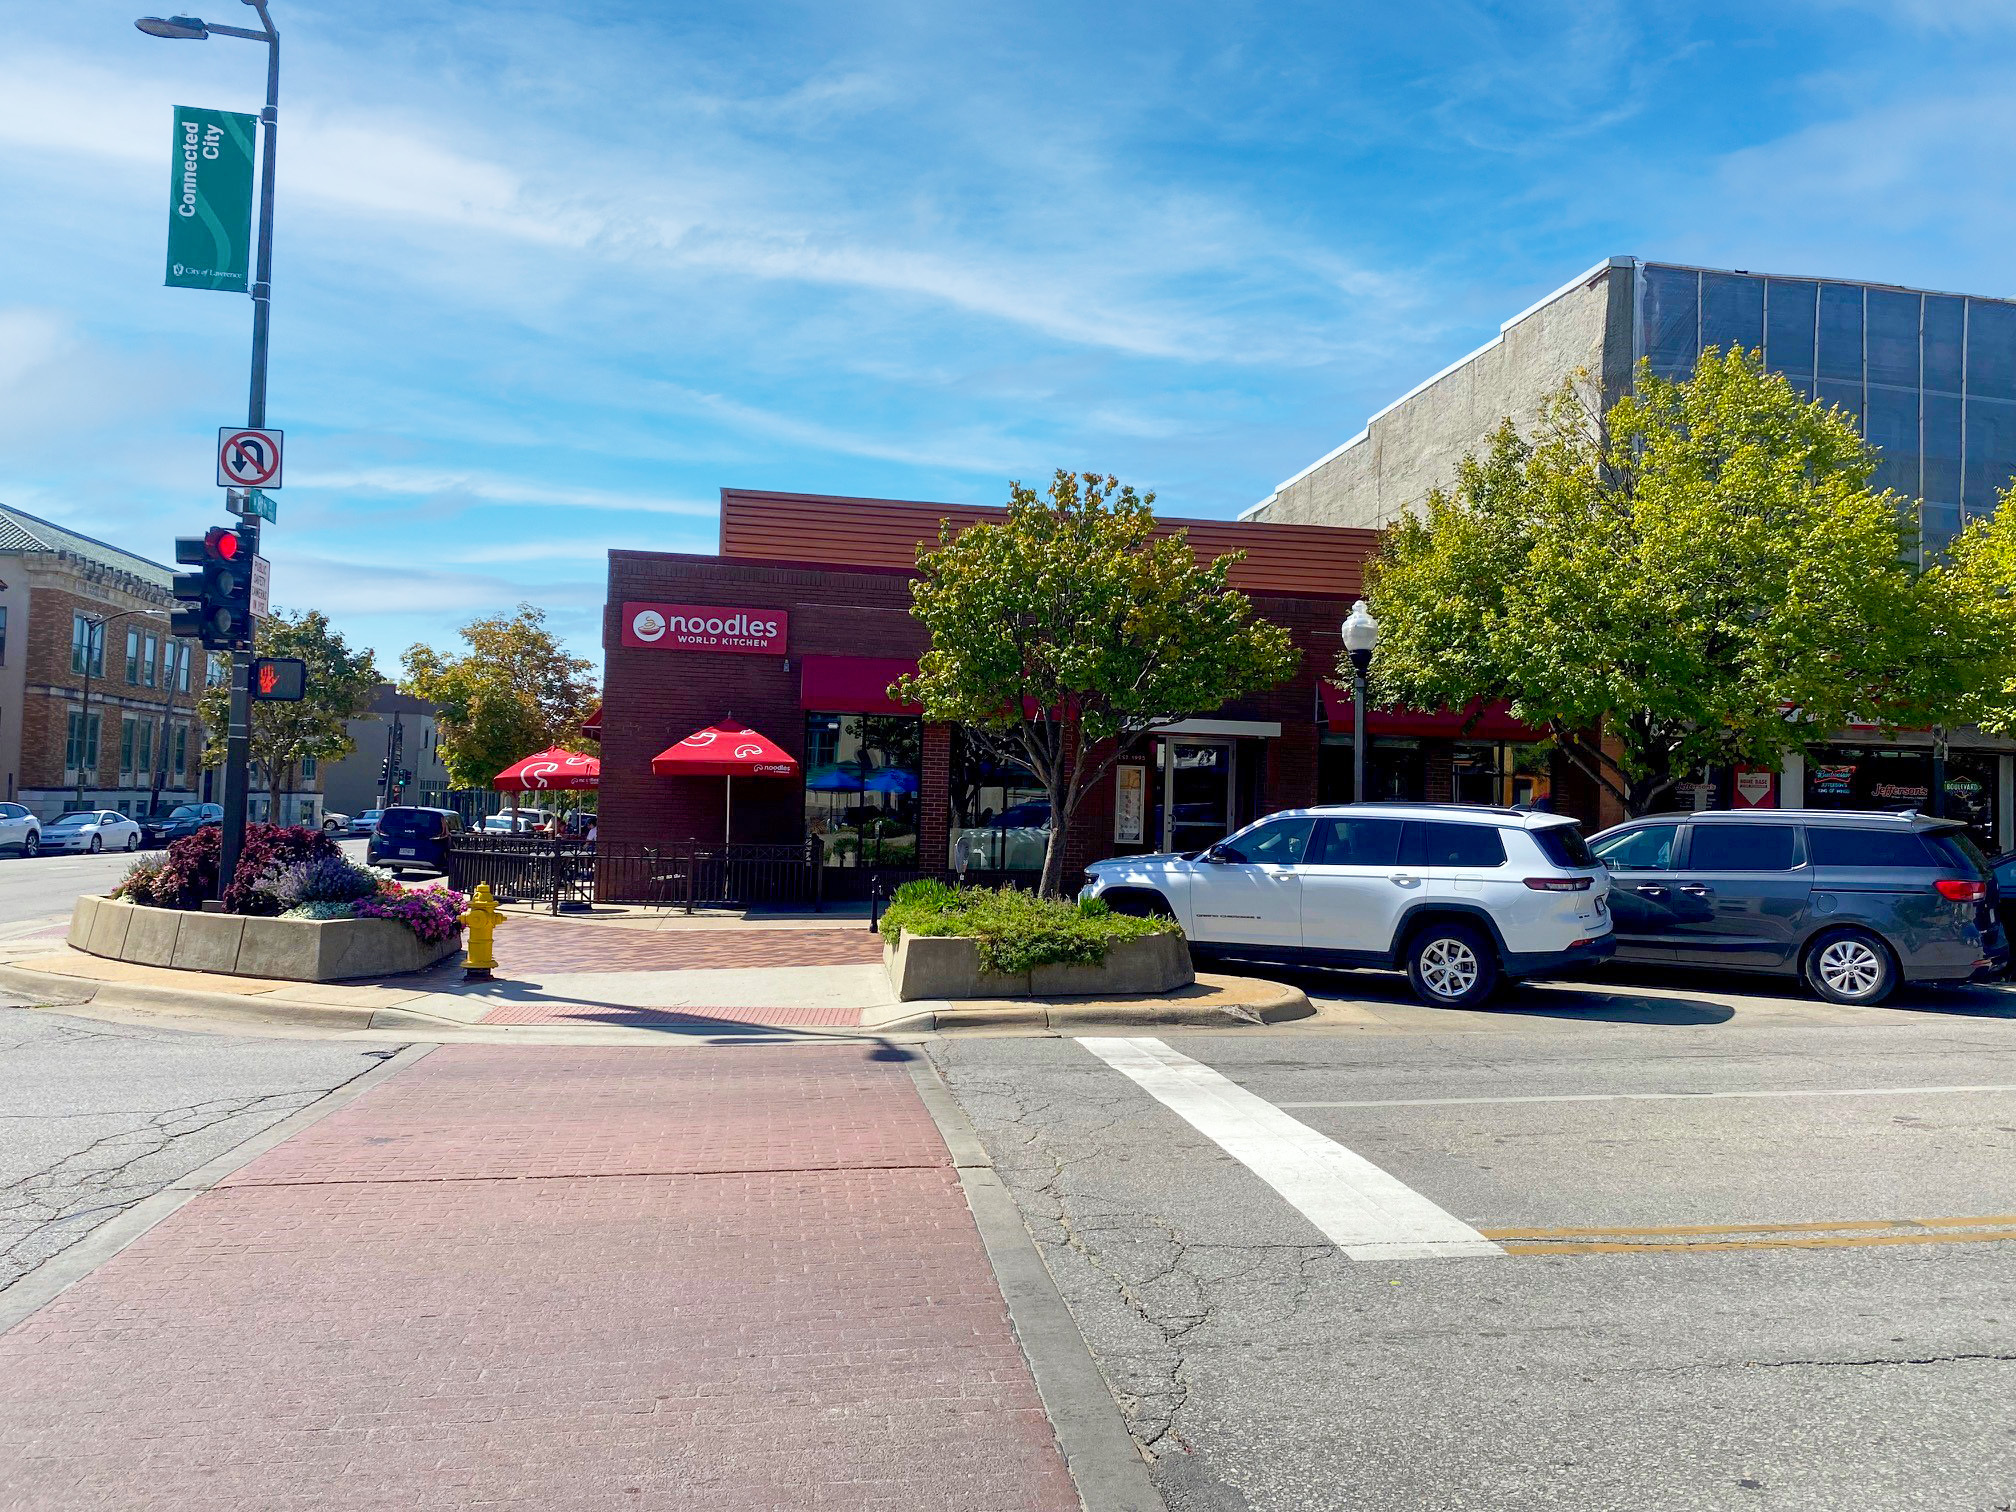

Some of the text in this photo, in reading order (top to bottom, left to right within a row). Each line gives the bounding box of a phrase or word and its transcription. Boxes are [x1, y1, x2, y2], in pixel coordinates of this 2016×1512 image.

[202, 123, 224, 160] City
[178, 121, 199, 217] Connected
[185, 267, 242, 279] City of Lawrence
[669, 614, 778, 638] noodles
[677, 635, 768, 648] WORLD KITCHEN
[764, 764, 791, 772] noodles
[1871, 783, 1928, 797] Jefferson's
[1946, 783, 1979, 791] BOULEVARD
